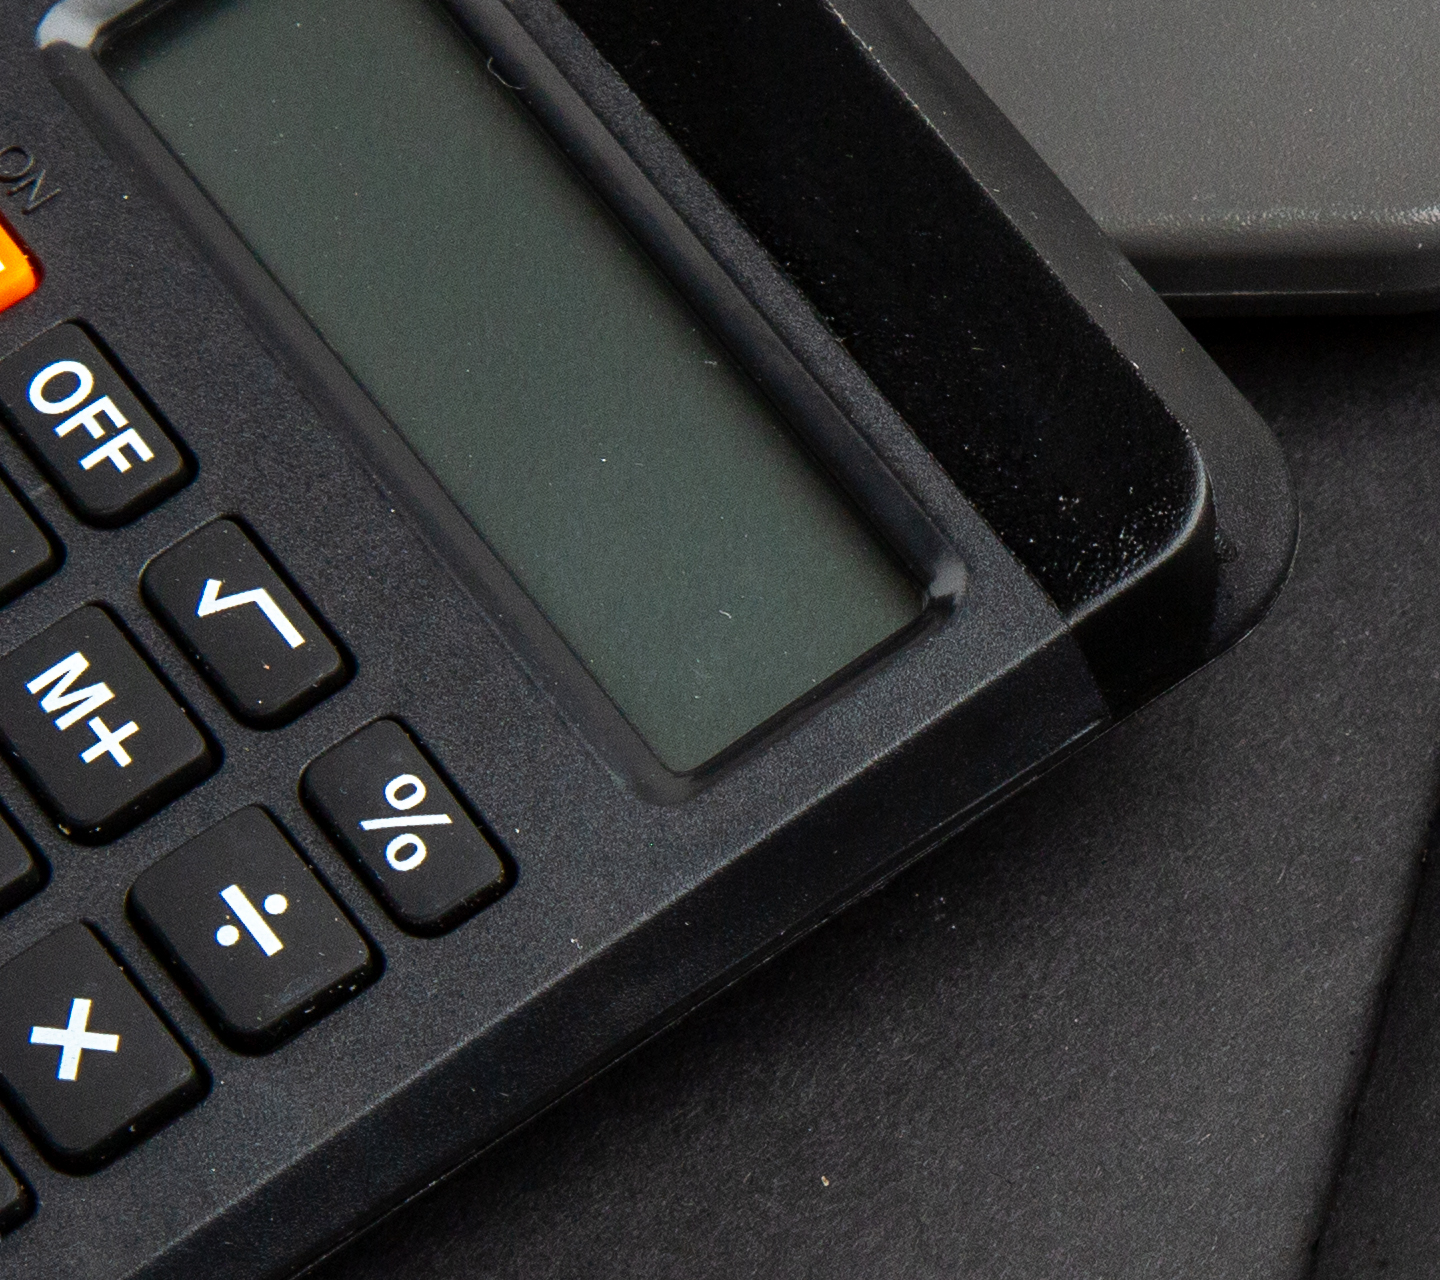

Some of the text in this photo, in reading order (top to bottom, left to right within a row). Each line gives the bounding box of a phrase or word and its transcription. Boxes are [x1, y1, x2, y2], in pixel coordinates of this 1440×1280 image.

[28, 359, 155, 474] OFF
[25, 650, 140, 769] M+
[359, 772, 454, 873] %
